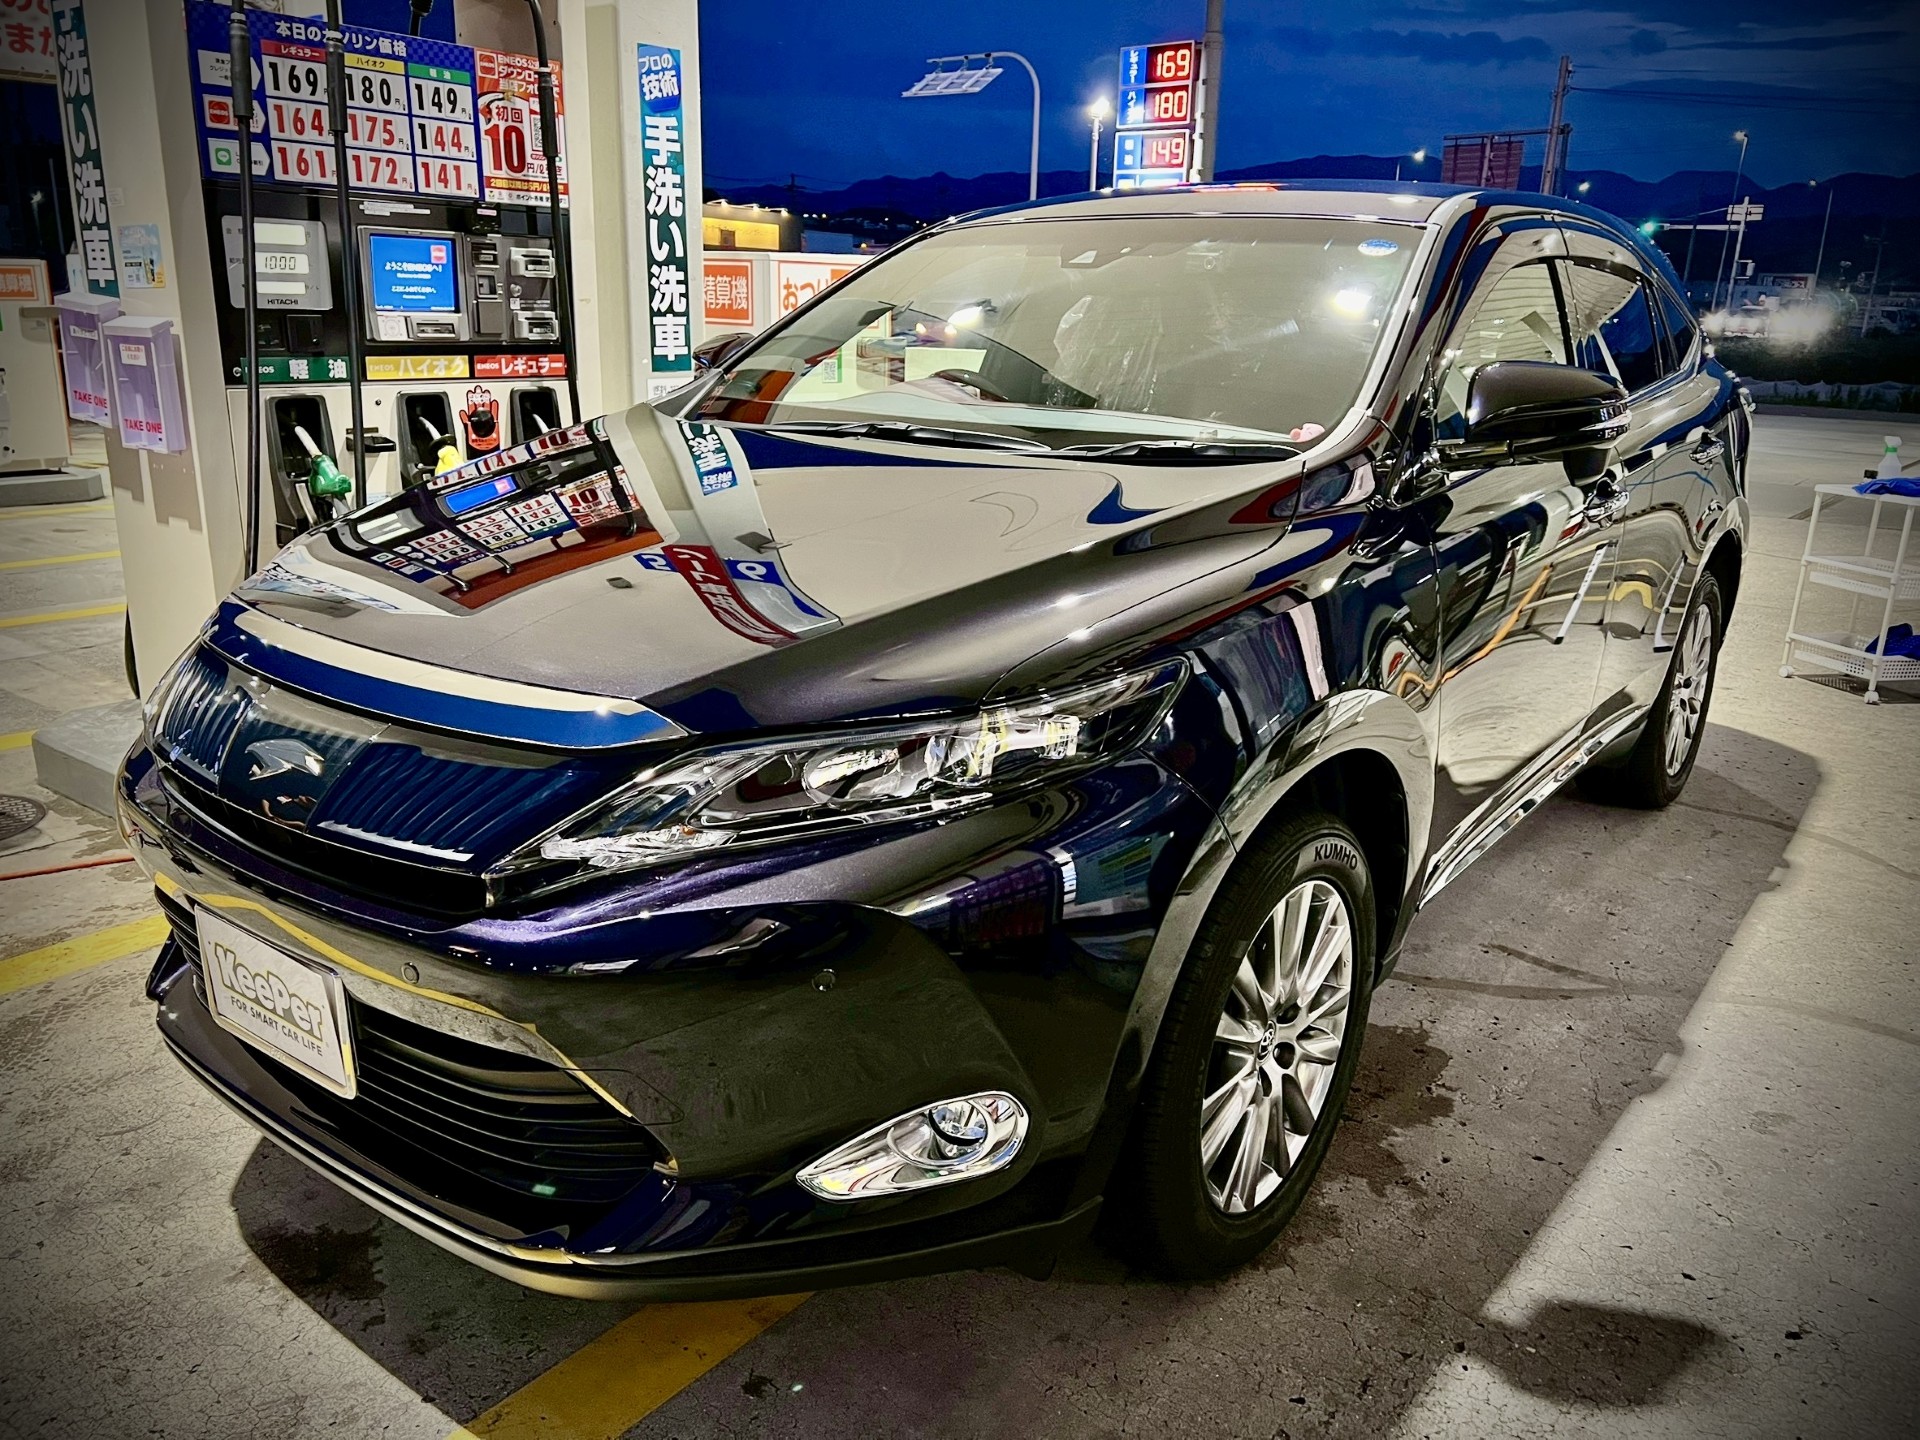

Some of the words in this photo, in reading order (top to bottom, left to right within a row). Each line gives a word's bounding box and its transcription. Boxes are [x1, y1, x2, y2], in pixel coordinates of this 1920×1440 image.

[280, 45, 320, 57] レギュラー
[356, 57, 385, 68] ハイオク
[639, 53, 673, 73] プロの
[1156, 49, 1190, 78] 169
[268, 62, 318, 96] 169
[345, 73, 392, 106] 180
[641, 70, 679, 100] 技術
[415, 83, 458, 113] 149
[1154, 90, 1187, 118] 180
[273, 104, 324, 137] 164
[496, 105, 523, 123] 初回
[348, 114, 395, 146] 175
[418, 123, 462, 153] 144
[277, 147, 327, 178] 161
[484, 124, 526, 174] 10
[1152, 138, 1185, 164] 149
[352, 154, 398, 185] 172
[421, 162, 462, 190] 141
[644, 116, 688, 361] 手洗い洗車
[704, 274, 748, 310] 精算機
[245, 366, 275, 374] EOS
[398, 357, 465, 376] ハイオク
[477, 362, 499, 370] ENEOS
[501, 357, 563, 375] レギュラー
[73, 390, 92, 404] TAKE
[93, 396, 107, 408] ONE
[124, 418, 144, 432] TAKE
[146, 421, 162, 434] ONE
[1313, 843, 1358, 870] KUMHO
[214, 942, 323, 1041] KeePer
[230, 995, 248, 1015] FOR
[250, 1007, 279, 1030] SMART
[282, 1025, 299, 1043] CAR
[302, 1037, 323, 1057] LIFE
